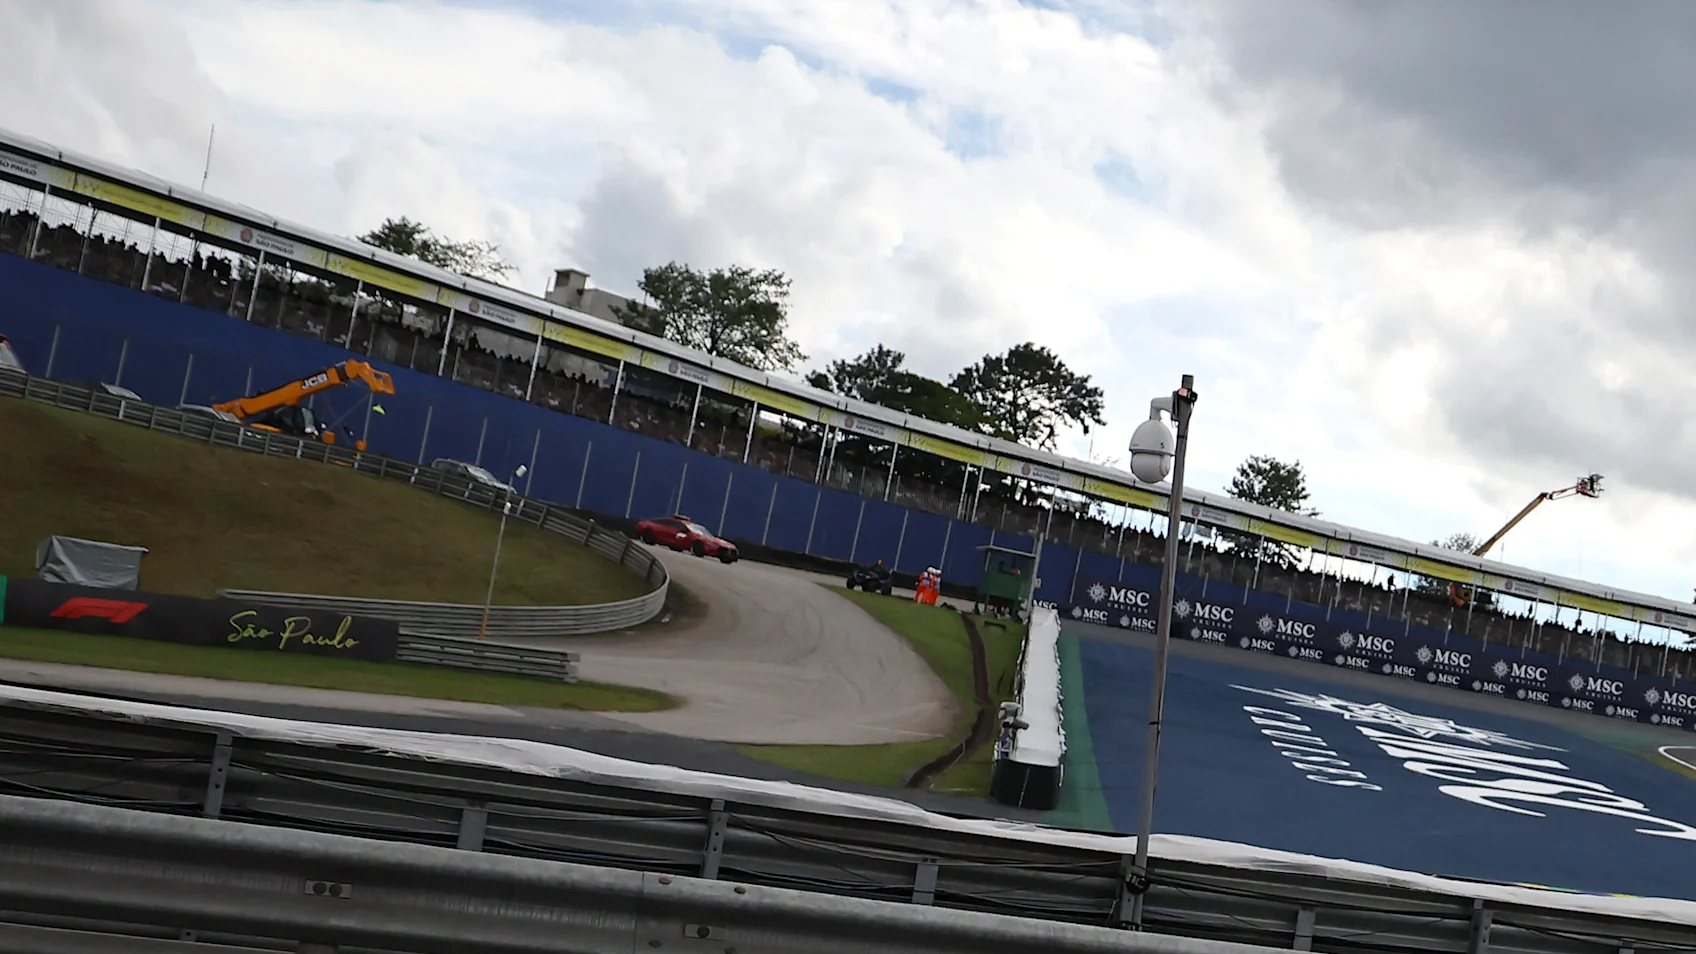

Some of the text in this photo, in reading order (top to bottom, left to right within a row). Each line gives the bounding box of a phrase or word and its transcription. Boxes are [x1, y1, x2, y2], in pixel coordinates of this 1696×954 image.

[302, 373, 328, 390] JCB
[1108, 586, 1150, 608] MSC
[1083, 608, 1108, 621] MSC
[1194, 602, 1234, 622] MSC
[227, 610, 360, 649] São Paulo
[1131, 617, 1156, 630] MSC
[1276, 618, 1316, 639] MSC
[1202, 629, 1227, 642] MSC
[1251, 638, 1275, 651] MSC
[1357, 634, 1394, 653] MSC
[1300, 647, 1323, 660] MSC
[1434, 649, 1471, 668] MSC
[1346, 656, 1369, 668] MSC
[1393, 664, 1416, 677] MSC
[1511, 663, 1548, 681] MSC
[1438, 673, 1460, 685] MSC
[1483, 682, 1505, 693] MSC
[1586, 677, 1623, 696] MSC
[1527, 690, 1549, 702] MSC
[1572, 698, 1594, 710] MSC
[1615, 706, 1638, 718] MSC
[1662, 715, 1684, 727] MSC
